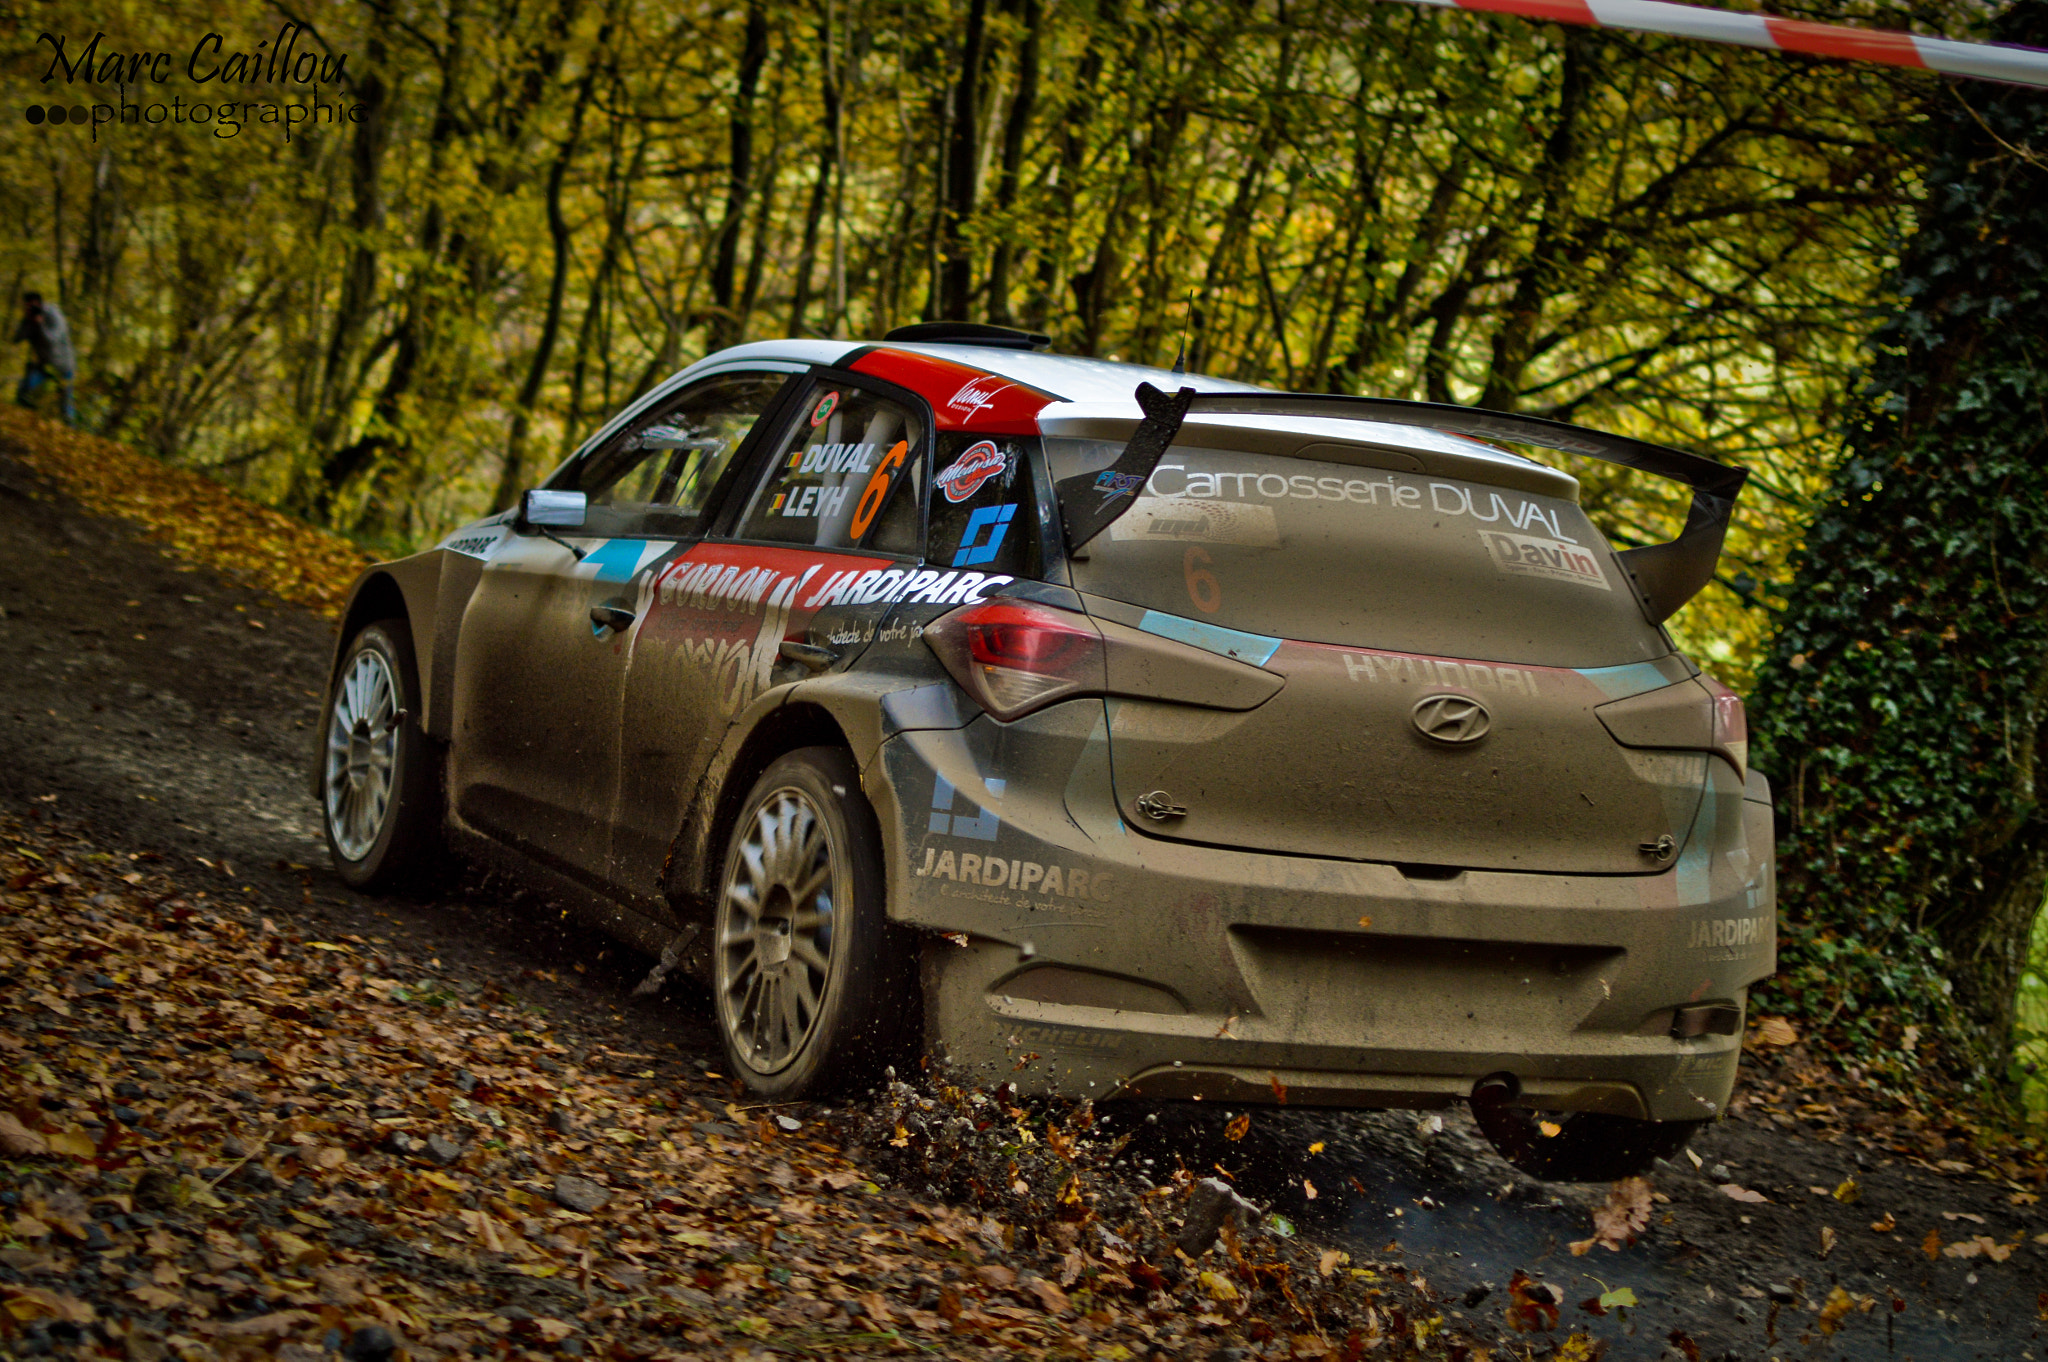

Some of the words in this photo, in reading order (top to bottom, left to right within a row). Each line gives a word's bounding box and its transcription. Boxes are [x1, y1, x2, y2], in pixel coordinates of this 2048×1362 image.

[799, 443, 876, 474] DUVAL
[782, 486, 850, 517] LEYH
[850, 440, 909, 540] 6
[1146, 464, 1422, 510] Carrosserie
[1428, 482, 1579, 545] DUVAL
[1487, 531, 1601, 579] Davin
[803, 568, 1015, 608] JARDIPARC
[1183, 545, 1222, 614] 6
[1342, 653, 1540, 698] HYUNDAI
[916, 847, 1115, 903] JARDIPARC
